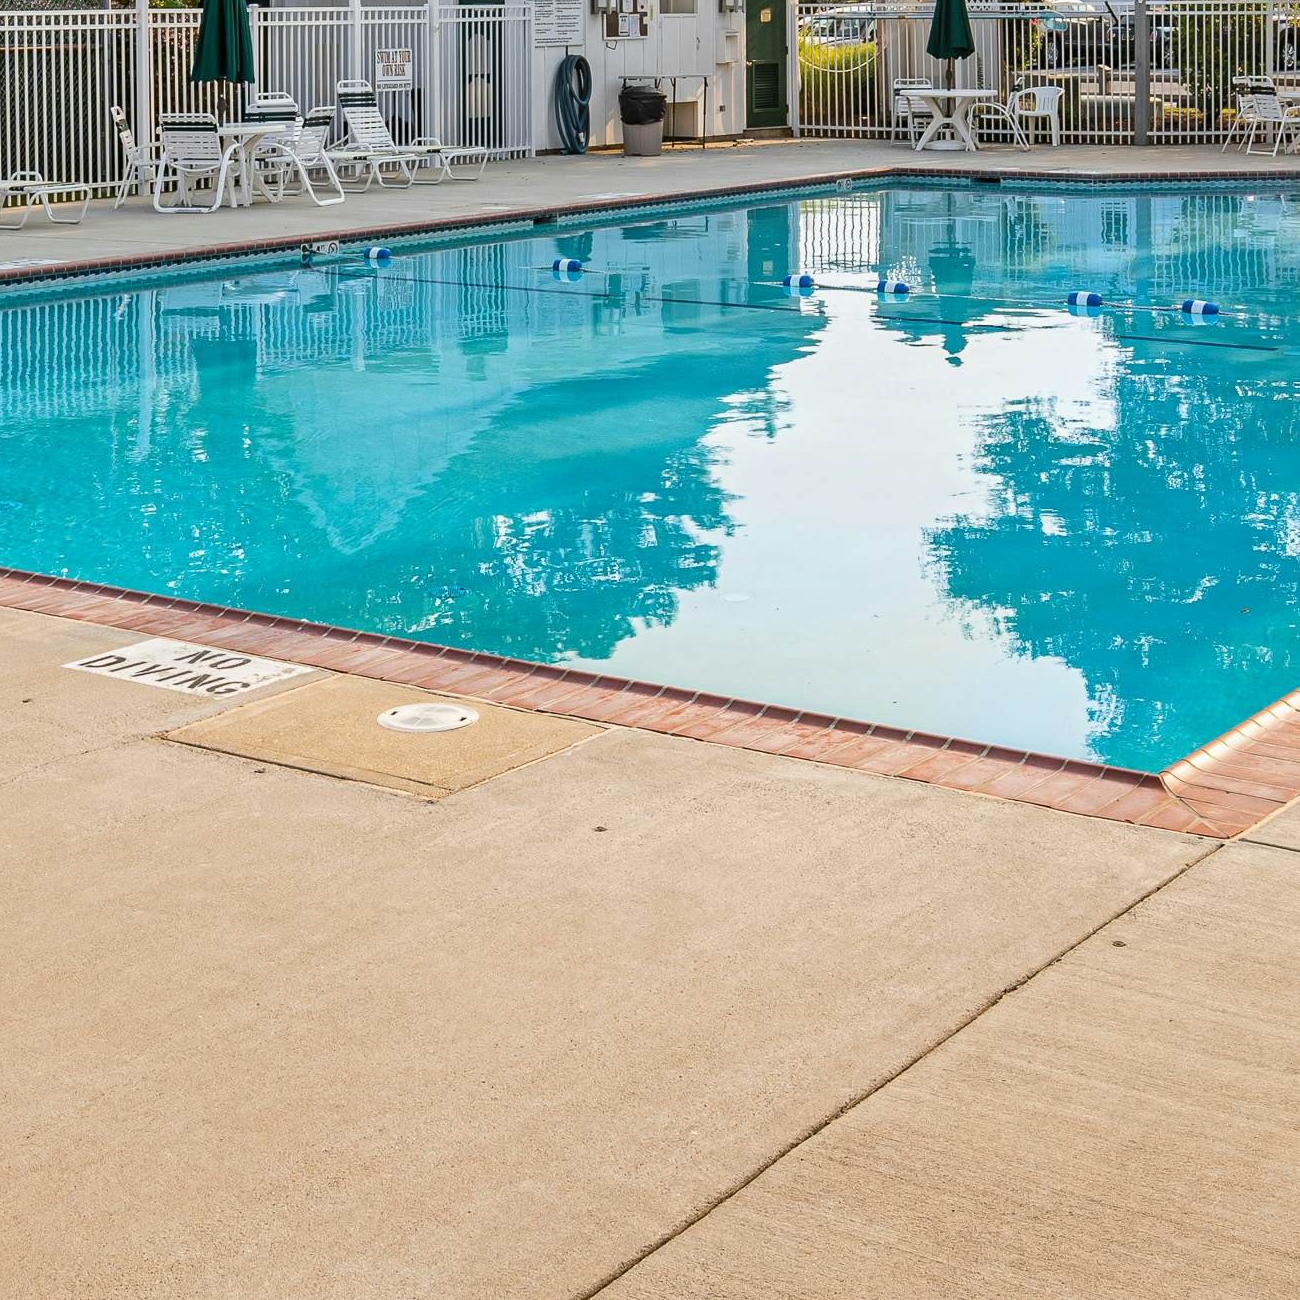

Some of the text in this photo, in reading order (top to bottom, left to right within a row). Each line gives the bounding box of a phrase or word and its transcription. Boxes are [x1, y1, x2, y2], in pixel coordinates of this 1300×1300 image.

[377, 50, 411, 64] SWIM AT YOUR
[382, 63, 406, 77] OWN RISK
[175, 650, 251, 670] NO
[78, 655, 251, 694] DIVING
